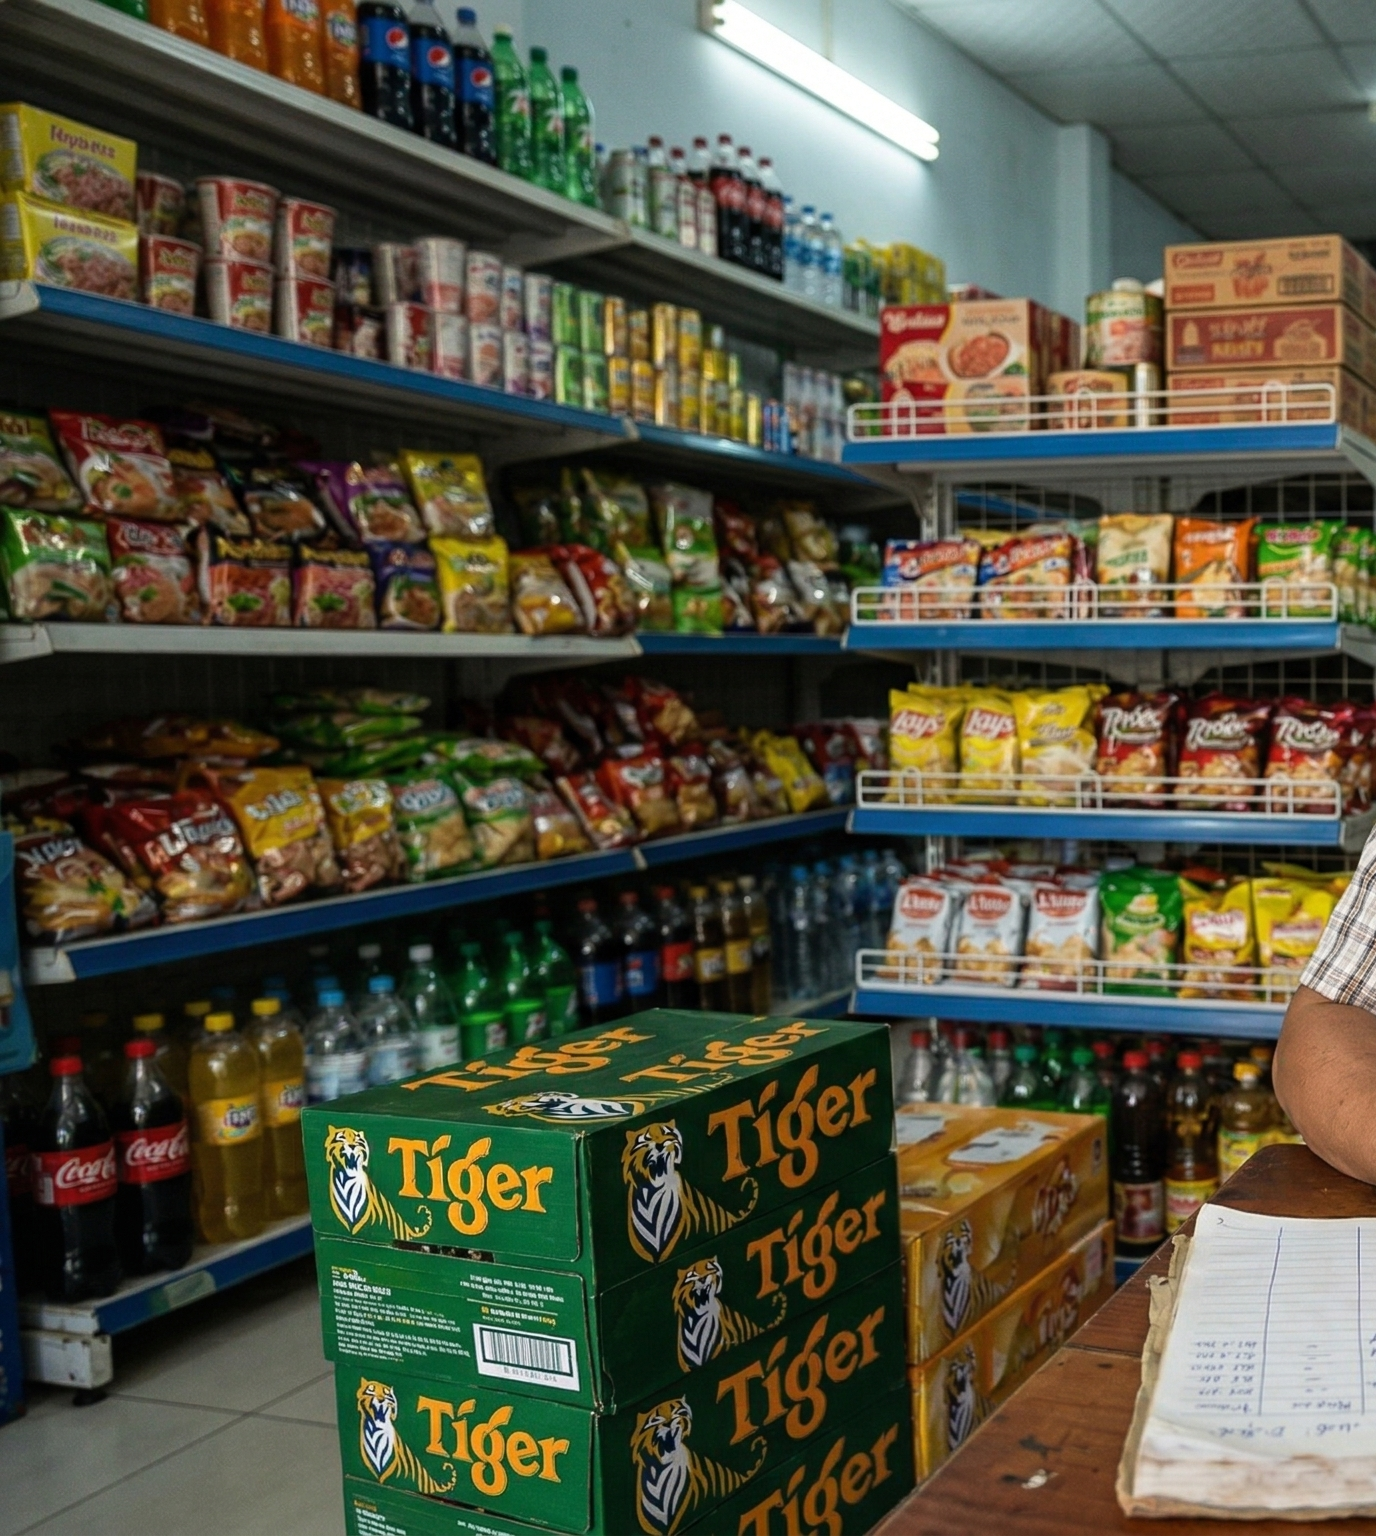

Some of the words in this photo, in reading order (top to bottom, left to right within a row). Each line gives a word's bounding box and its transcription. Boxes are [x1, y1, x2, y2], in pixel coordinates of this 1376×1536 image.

[404, 1026, 657, 1092] Tiger
[620, 1022, 830, 1085] Tiger
[707, 1064, 877, 1188] Tiger
[387, 1134, 554, 1236] Tiger
[746, 1190, 888, 1299] Tiger
[716, 1305, 886, 1440] Tiger
[417, 1396, 569, 1496] Tiger
